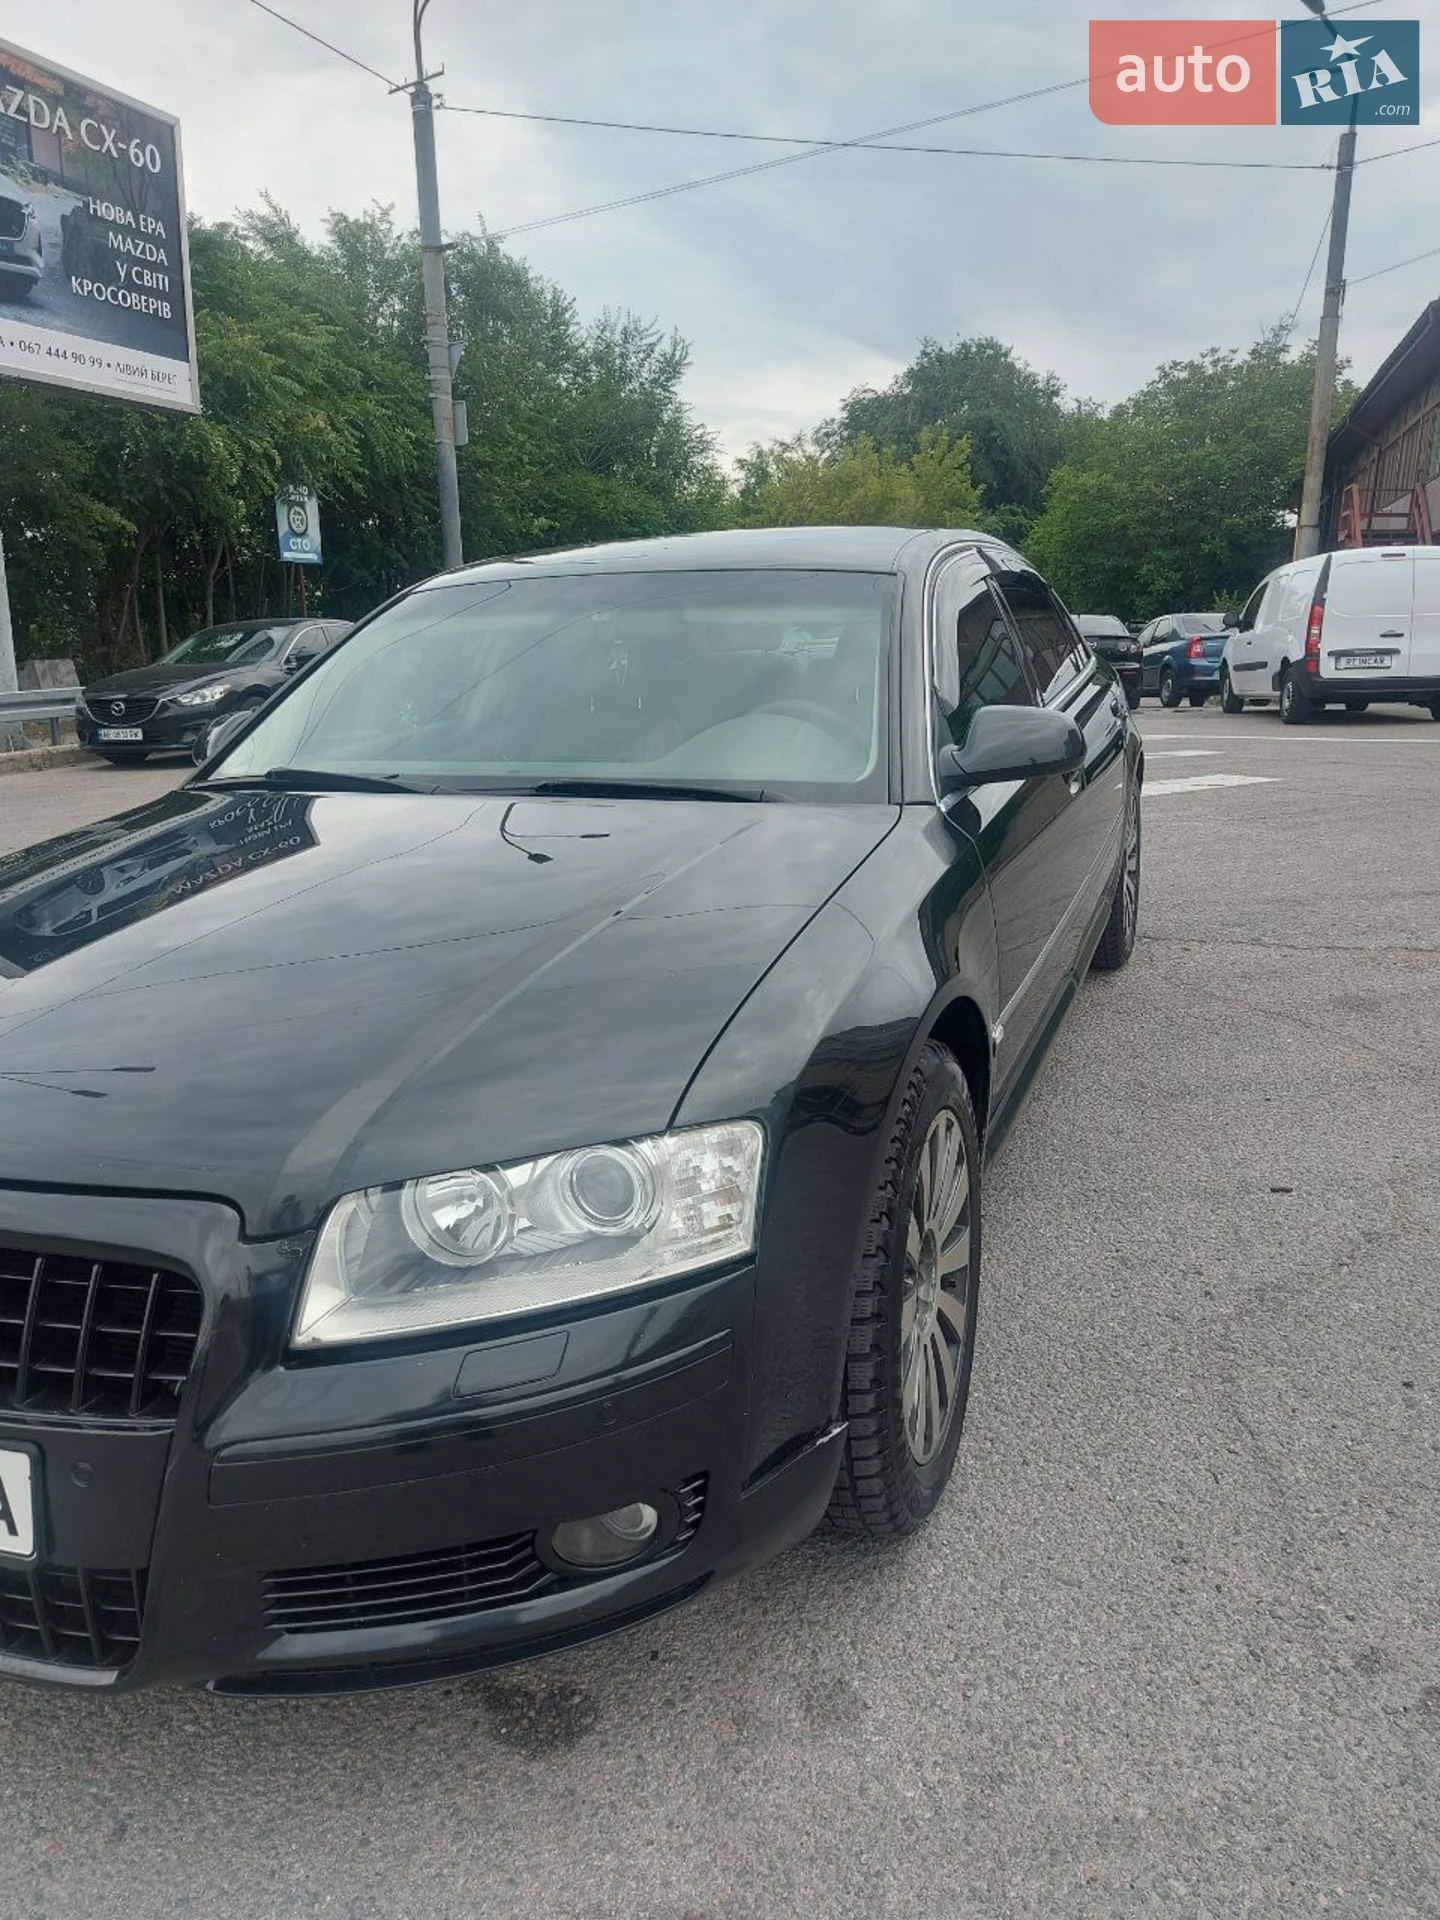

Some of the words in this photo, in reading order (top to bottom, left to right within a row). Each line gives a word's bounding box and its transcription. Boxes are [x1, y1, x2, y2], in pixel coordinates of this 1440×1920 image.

[0, 84, 74, 141] ZDA
[80, 117, 162, 174] CX-60
[89, 196, 136, 229] НОВА
[139, 214, 167, 239] ЕРА
[108, 230, 169, 267] MAZDA
[116, 260, 127, 283] У
[131, 266, 169, 293] СВІТІ
[71, 275, 172, 319] КРОСОВЕРІВ
[18, 339, 42, 356] 067
[45, 346, 68, 360] 444
[71, 351, 86, 366] 90
[88, 355, 103, 369] 99
[288, 538, 311, 550] СТО
